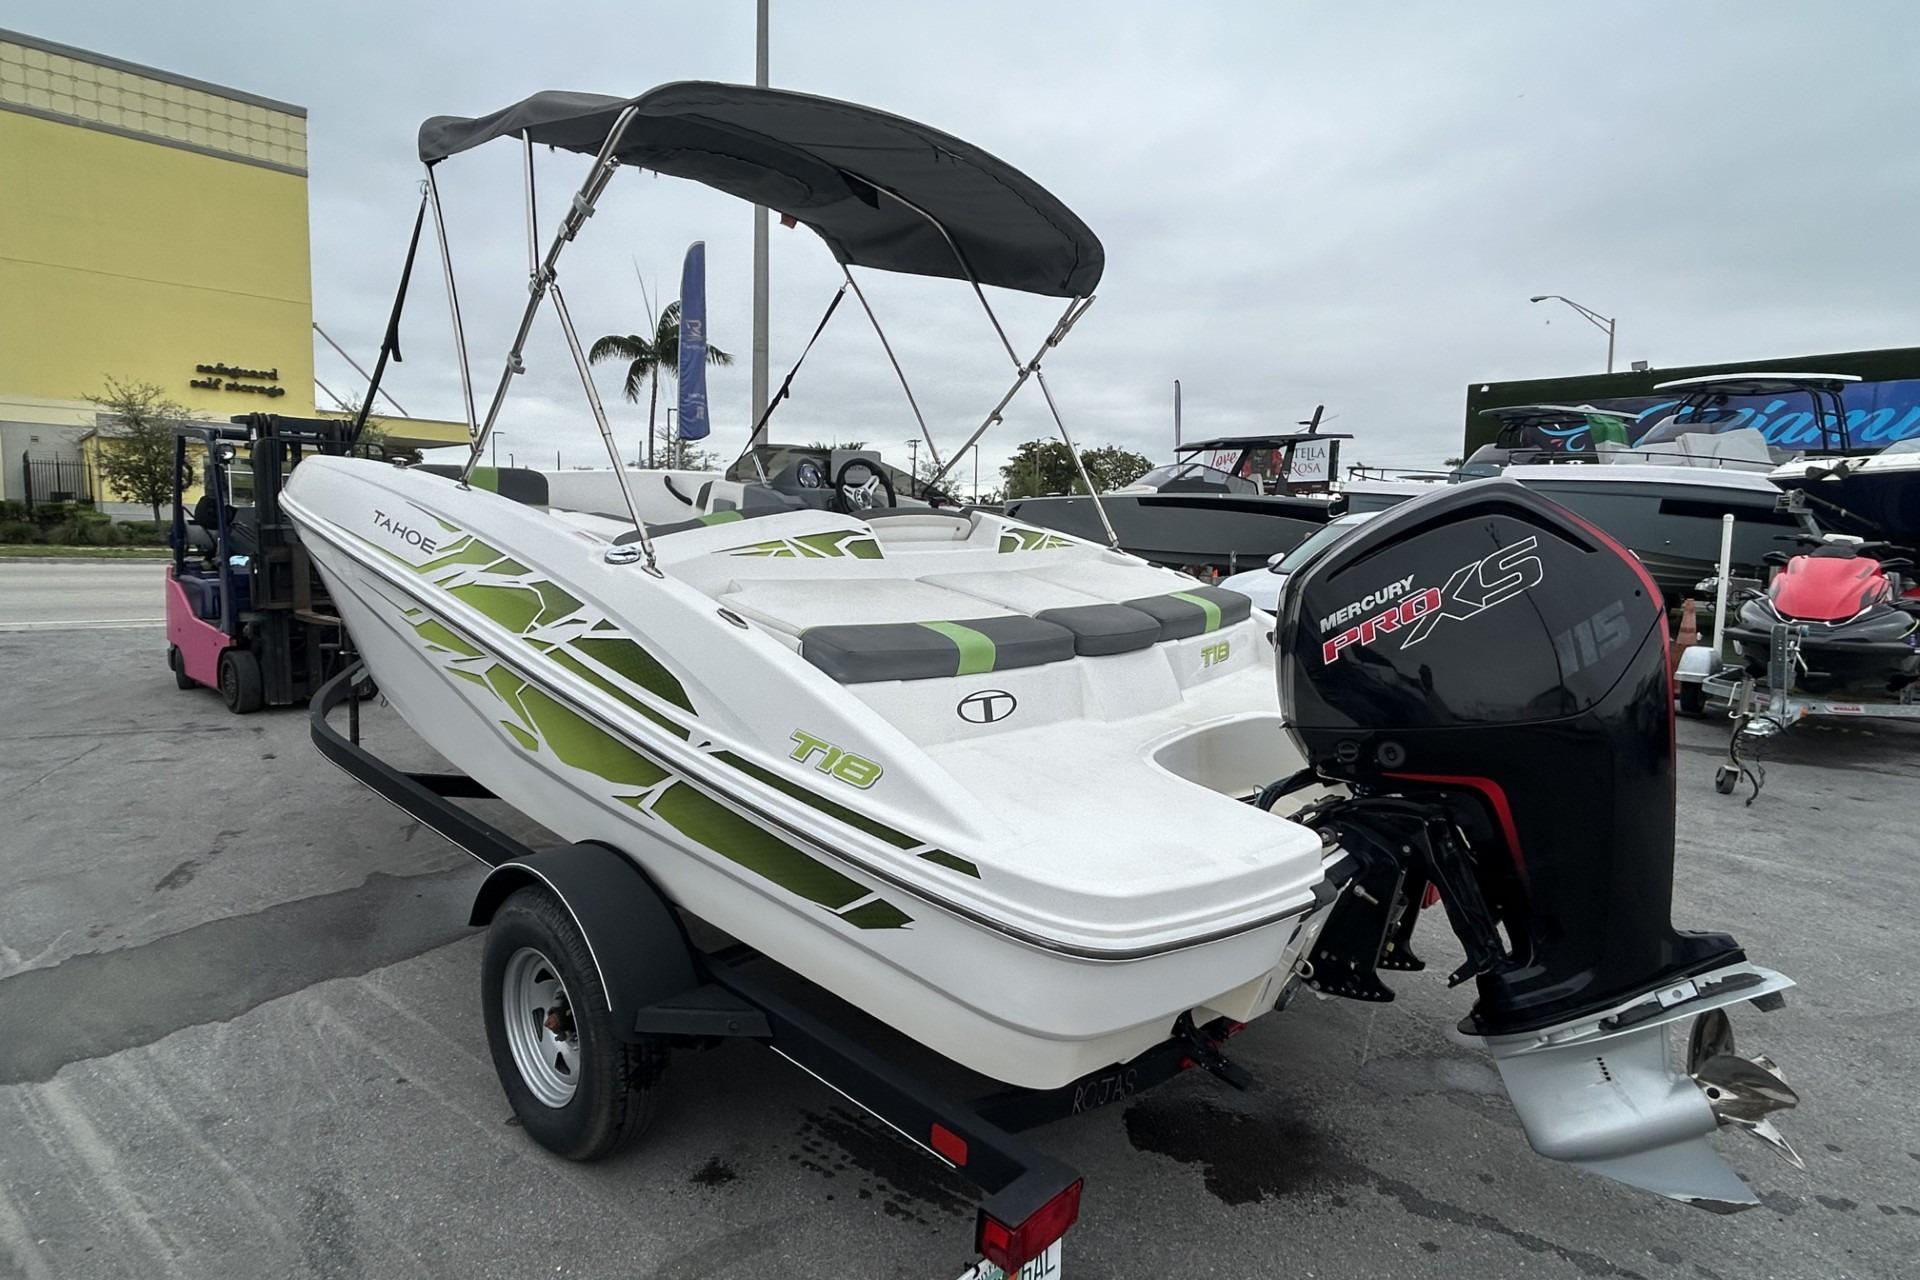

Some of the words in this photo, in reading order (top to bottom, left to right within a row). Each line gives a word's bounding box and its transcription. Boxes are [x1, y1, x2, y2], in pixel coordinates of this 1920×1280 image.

[190, 377, 222, 390] self
[196, 363, 279, 380] safeguard
[1294, 446, 1326, 461] TELLA
[374, 509, 437, 555] TAHOE
[1320, 574, 1414, 634] MERCURY
[1322, 587, 1442, 666] PRO
[1200, 640, 1230, 668] T18
[1553, 599, 1633, 679] 115
[789, 730, 883, 790] T18
